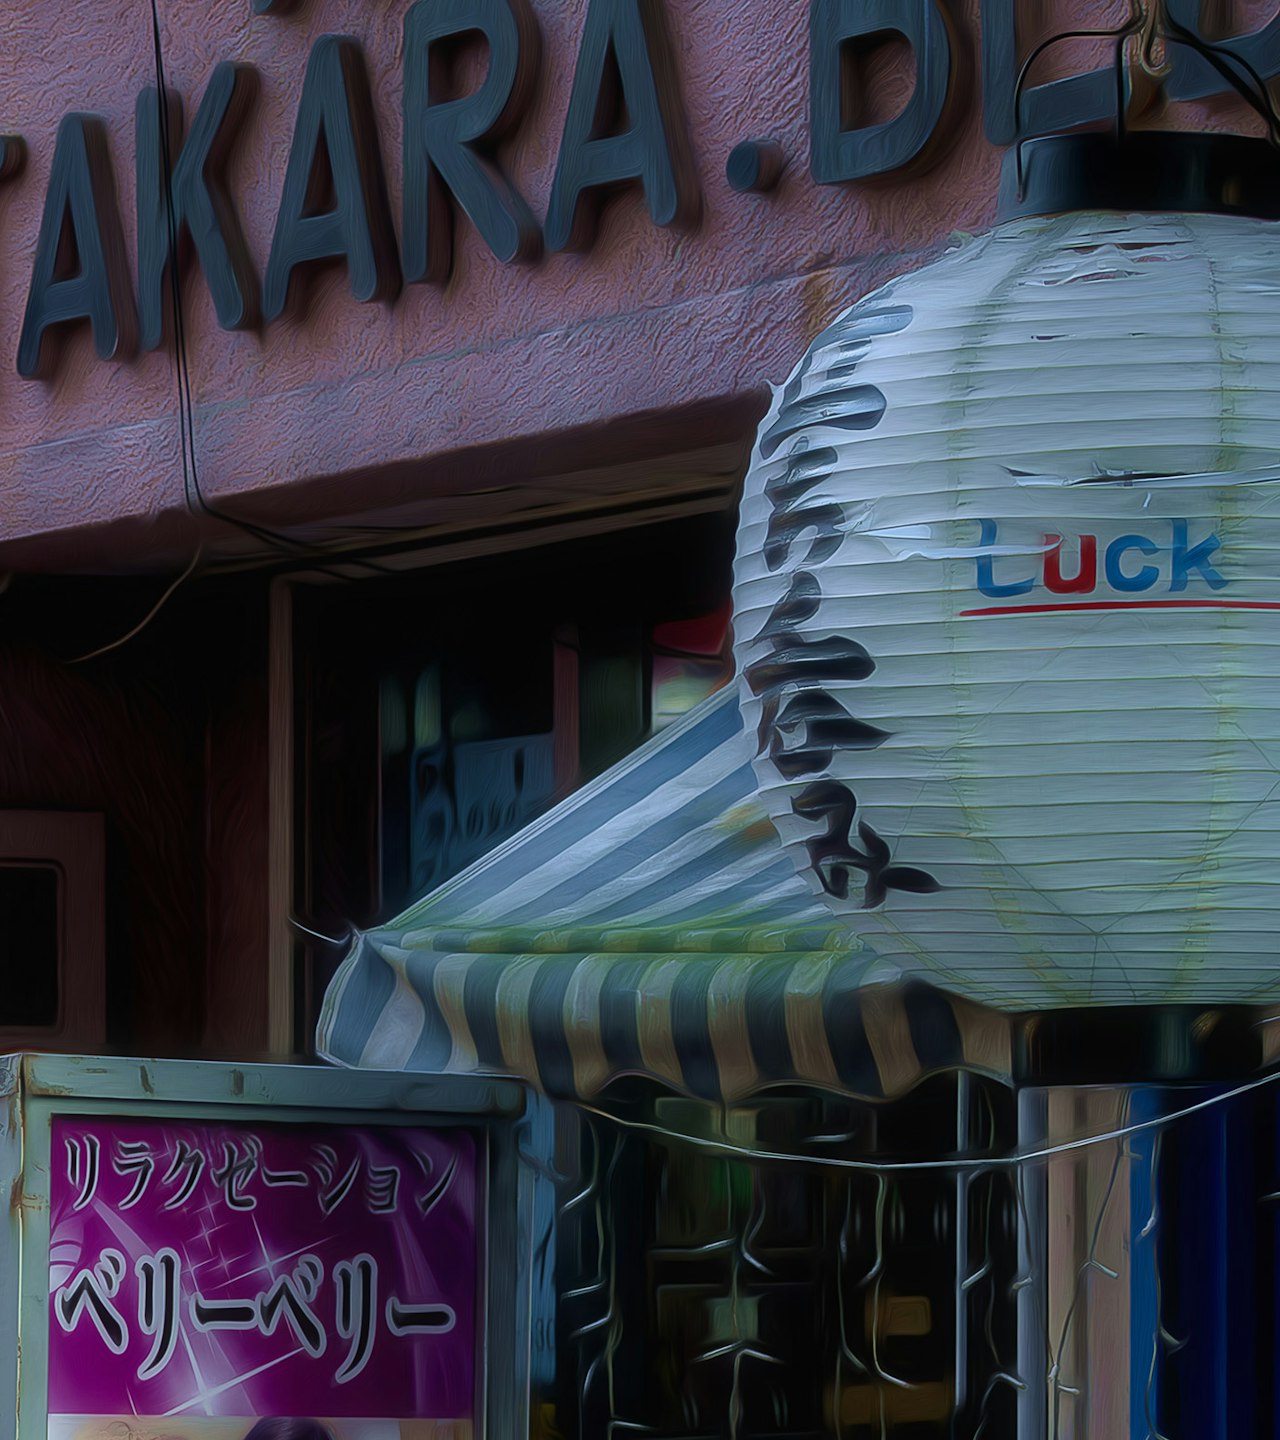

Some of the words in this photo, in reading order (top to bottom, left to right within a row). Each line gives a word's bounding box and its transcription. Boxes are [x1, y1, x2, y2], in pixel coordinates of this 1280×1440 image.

[975, 516, 1232, 600] Luck
[64, 1132, 459, 1214] リラクゼーション
[54, 1247, 456, 1384] ベリーベリー
